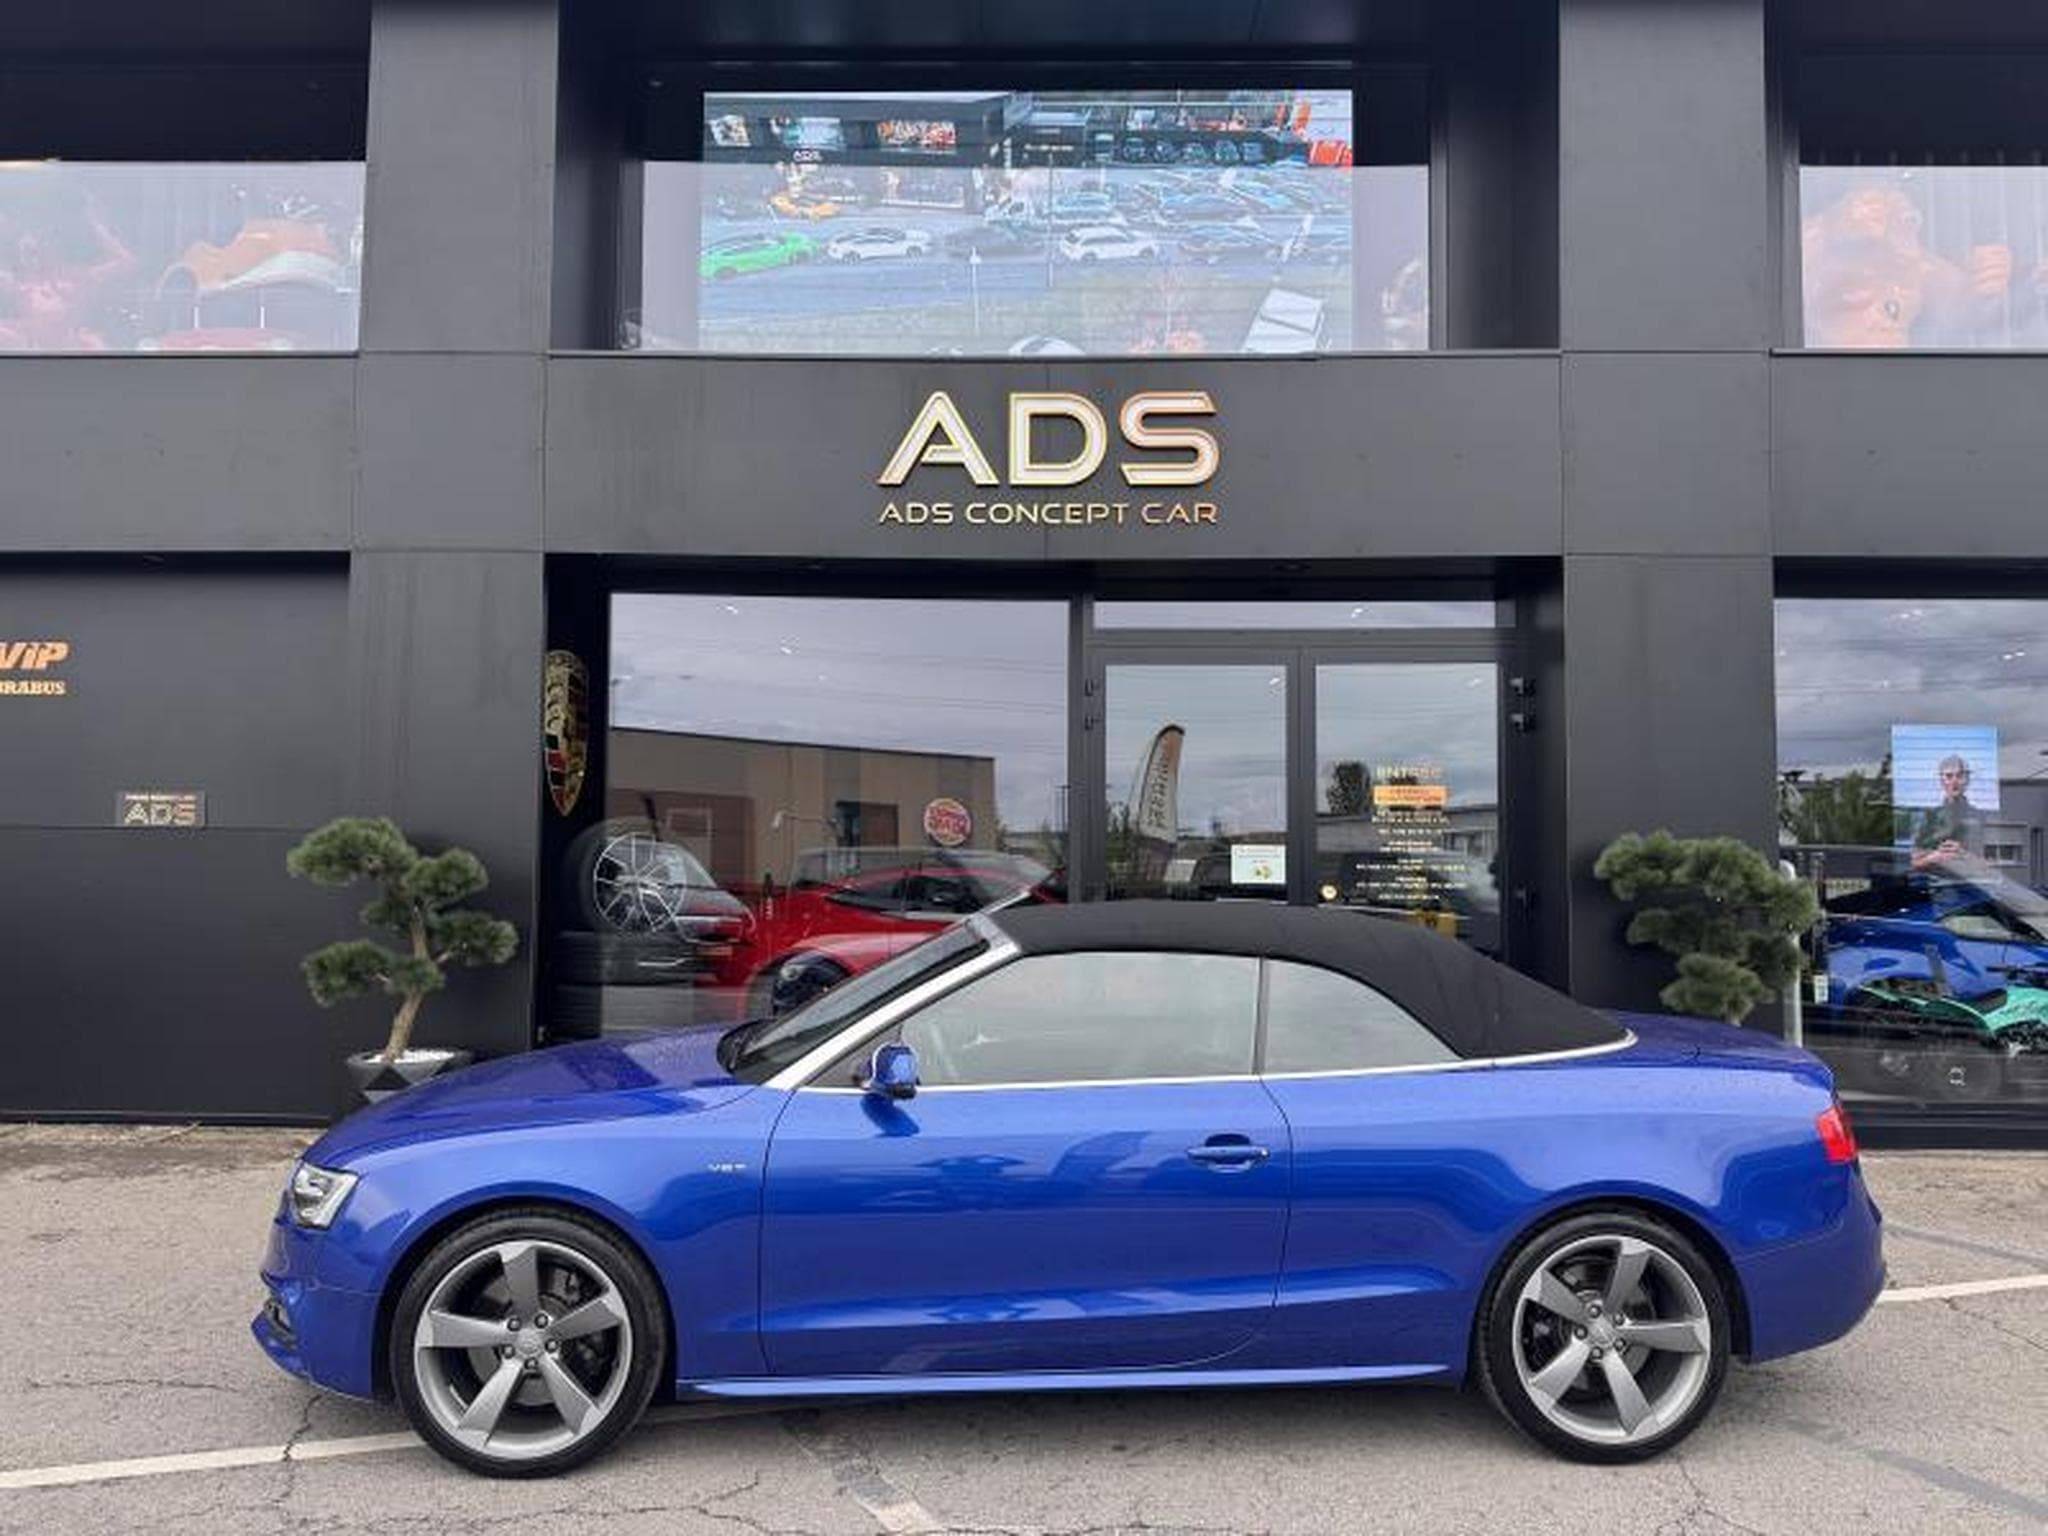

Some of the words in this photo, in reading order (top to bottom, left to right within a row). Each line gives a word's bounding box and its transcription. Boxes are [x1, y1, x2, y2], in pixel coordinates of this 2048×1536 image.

[877, 391, 1220, 486] ADS
[878, 502, 955, 525] ADS
[965, 502, 1130, 525] CONCEPT
[1140, 502, 1218, 525] CAR
[124, 802, 195, 825] ADS
